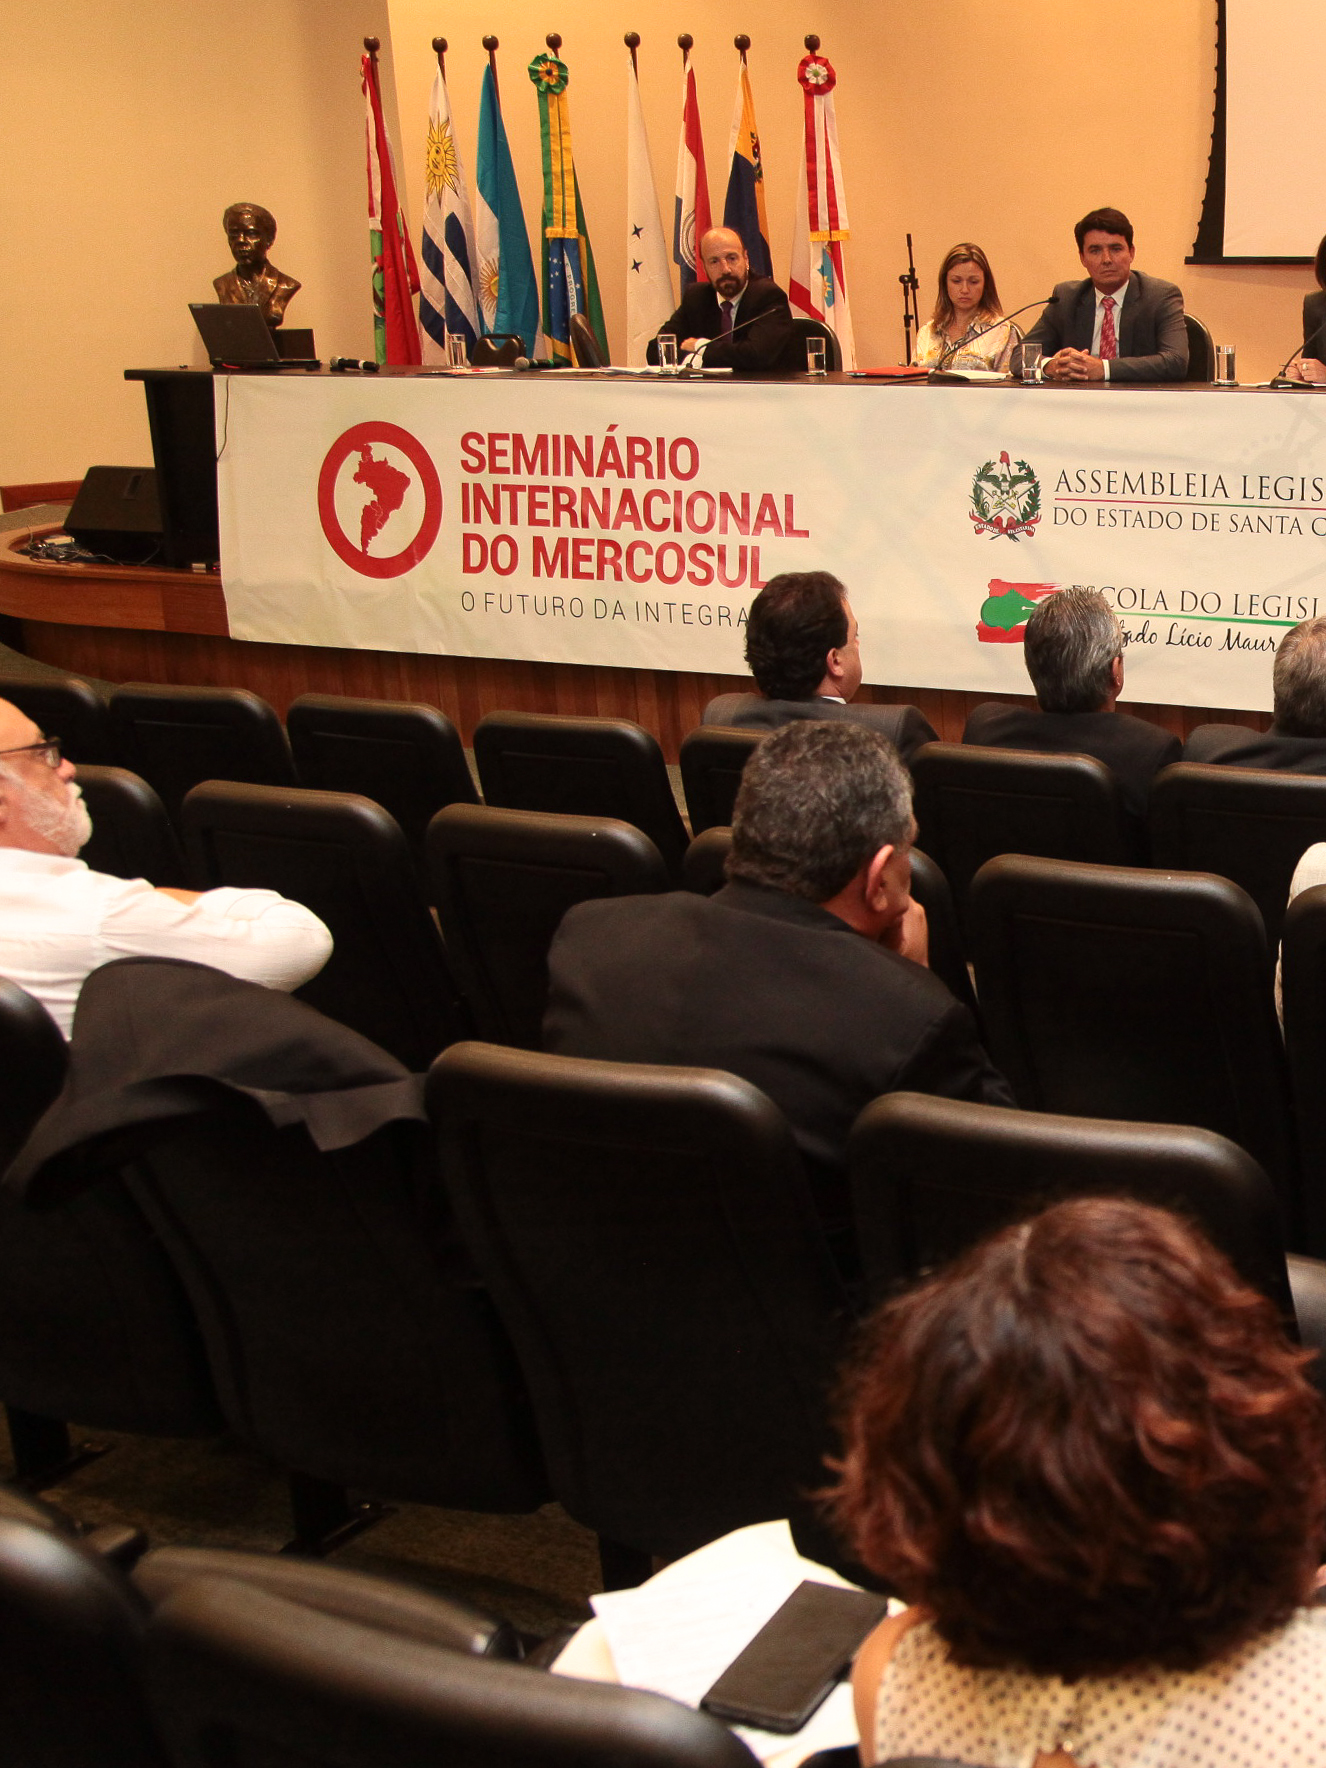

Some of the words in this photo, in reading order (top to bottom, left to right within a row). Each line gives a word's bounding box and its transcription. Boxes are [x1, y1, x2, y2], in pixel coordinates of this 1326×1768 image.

[460, 424, 699, 481] SEMINÁRIO
[1053, 468, 1230, 499] ASSEMBLEIA
[461, 482, 810, 539] INTERNACIONAL
[1053, 506, 1088, 526] DO
[1096, 508, 1183, 530] ESTADO
[1192, 512, 1221, 532] DE
[1229, 513, 1303, 535] SANTA
[462, 533, 519, 576] DO
[532, 535, 770, 590] MERCOSUL
[461, 591, 475, 612] O
[484, 592, 584, 618] FUTURO
[594, 598, 626, 621] DA
[635, 601, 750, 627] INTEGRA
[1072, 585, 1169, 611] COLA
[1180, 590, 1222, 614] DO
[1165, 622, 1213, 648] Lício
[1218, 628, 1279, 652] Maur
